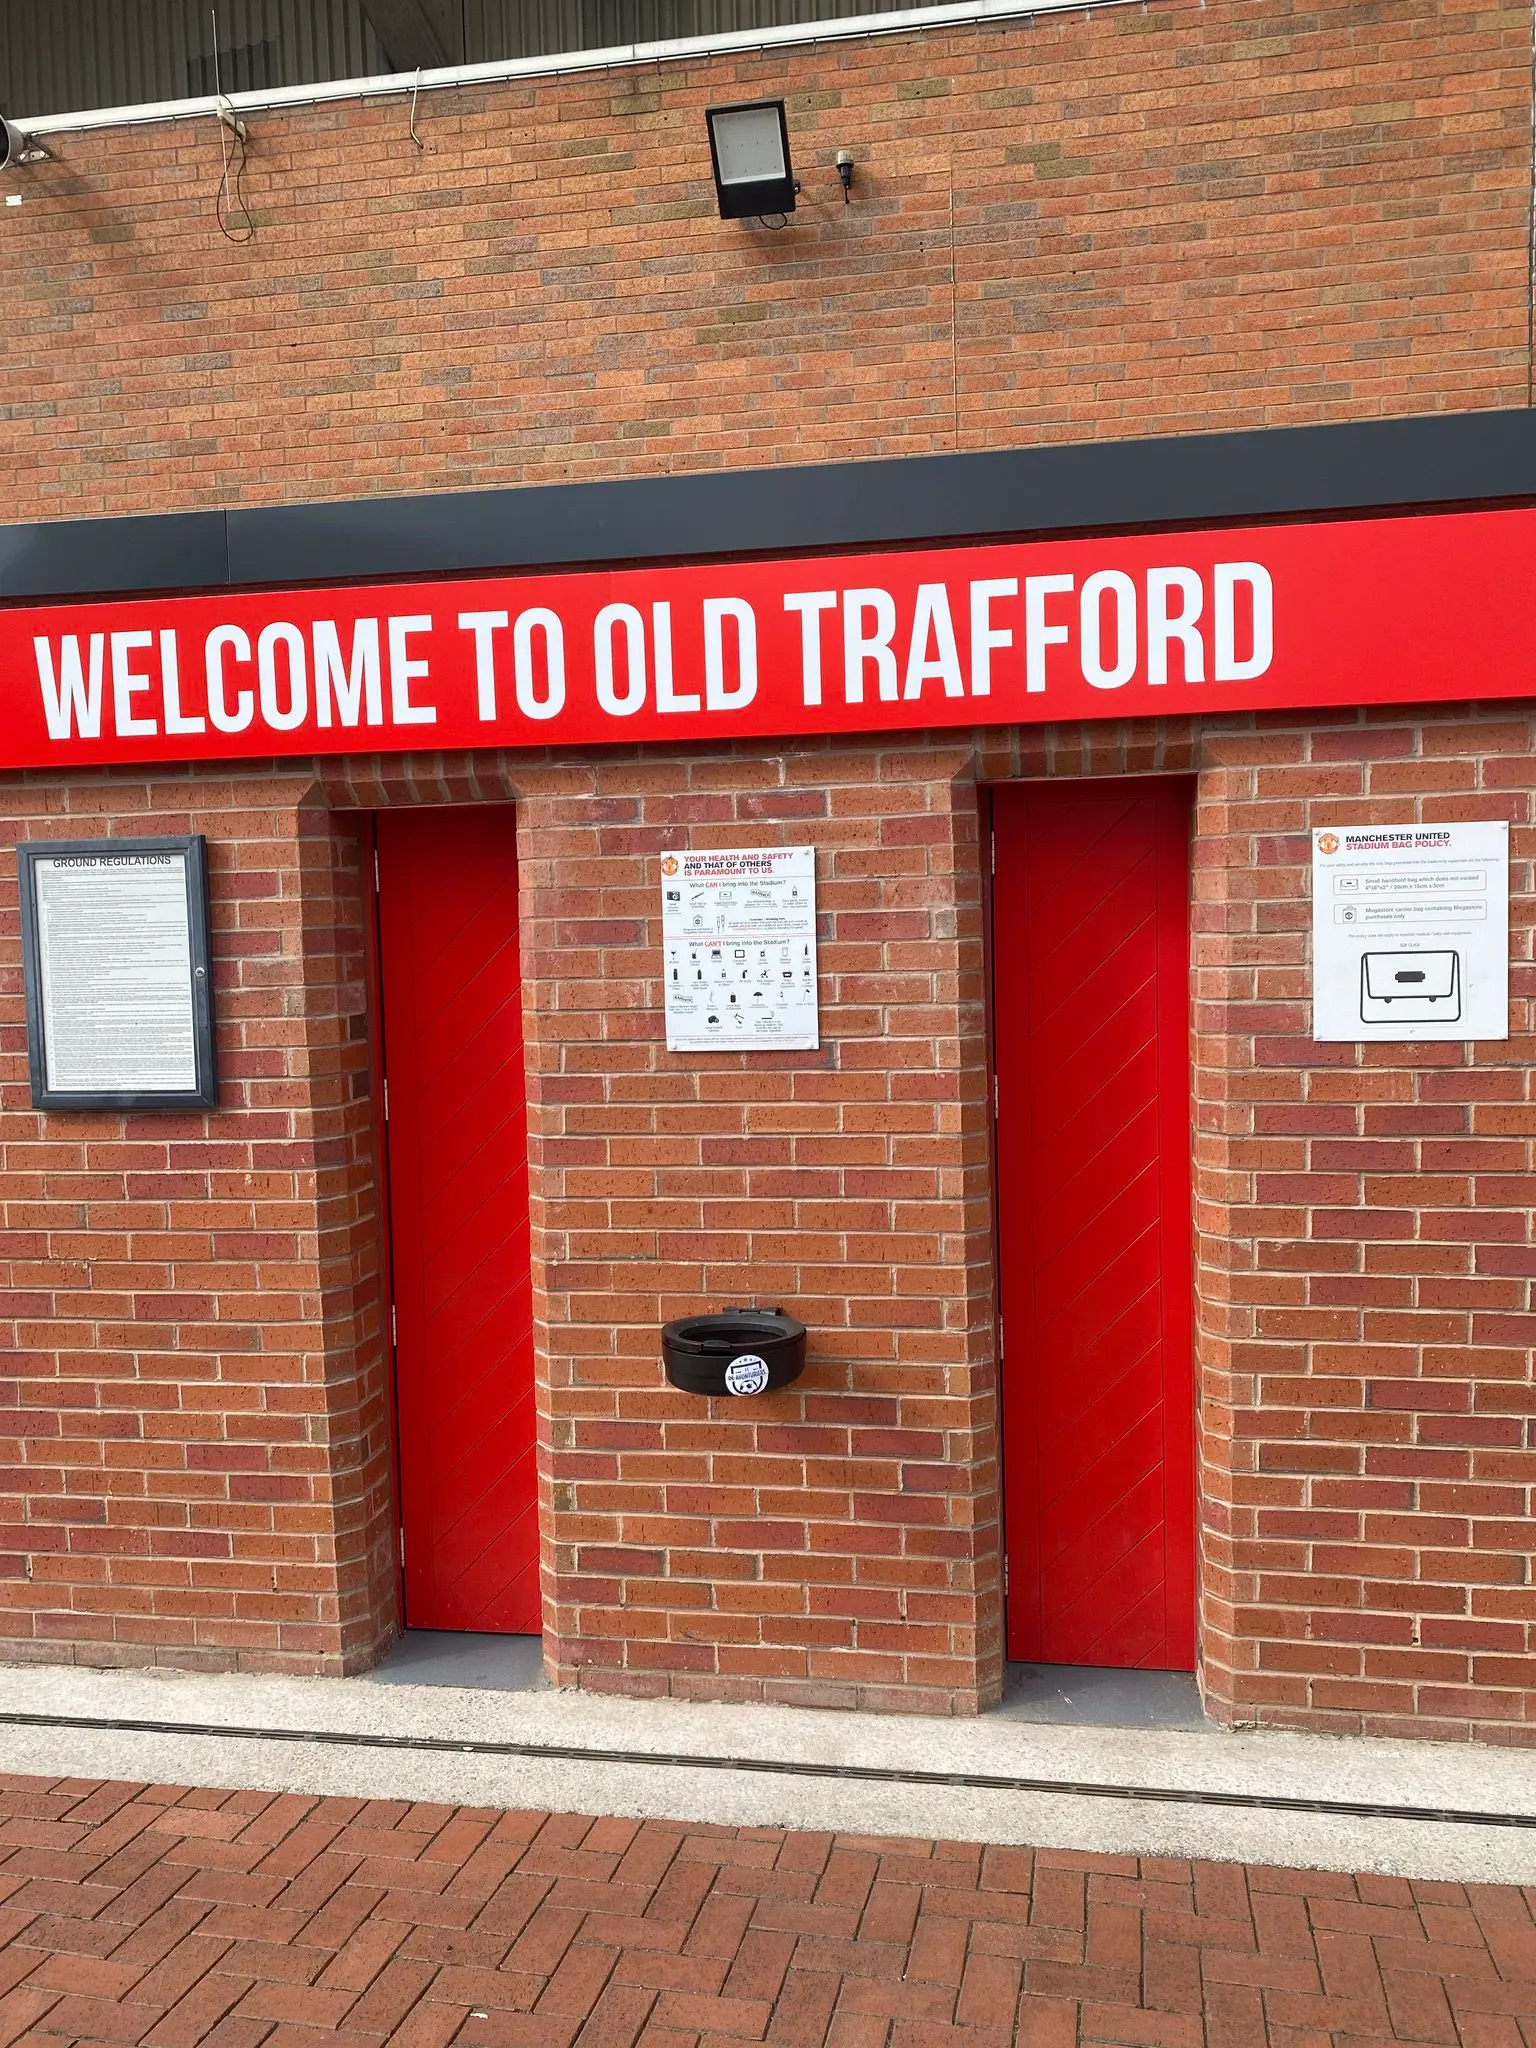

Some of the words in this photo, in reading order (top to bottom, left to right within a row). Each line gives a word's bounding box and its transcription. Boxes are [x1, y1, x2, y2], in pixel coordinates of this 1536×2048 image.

[33, 614, 437, 740] WELCOME
[457, 607, 567, 722] TO
[593, 597, 758, 717] OLD
[783, 561, 1274, 707] TRAFFORD
[1345, 833, 1413, 843] MANCHESTER
[1415, 832, 1450, 841] UNITED
[1345, 841, 1390, 850] STADIUM
[1391, 841, 1413, 849] BAG
[1415, 840, 1451, 848] POLICY.
[53, 857, 96, 868] GROUND
[99, 855, 171, 867] REGULATIONS
[684, 855, 707, 863] YOUR
[708, 854, 739, 862] HEALTH
[761, 852, 794, 860] SAFETY
[684, 862, 702, 870] AND
[739, 860, 772, 868] OTHERS
[694, 868, 747, 876] PARAMOUNT
[1365, 907, 1395, 915] Megastore
